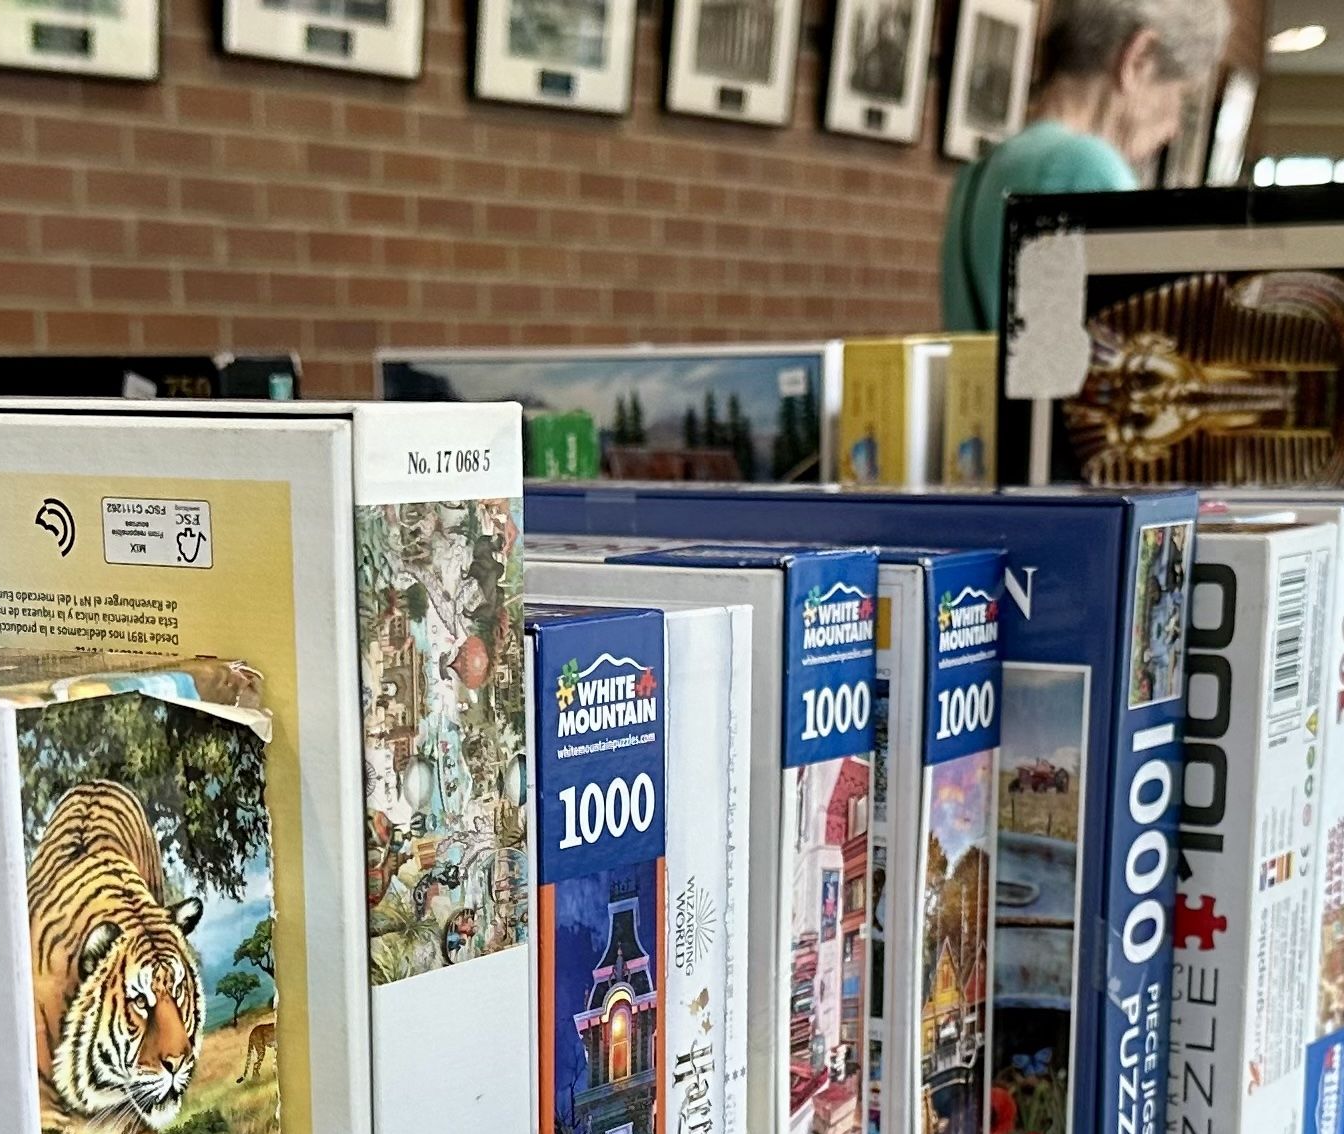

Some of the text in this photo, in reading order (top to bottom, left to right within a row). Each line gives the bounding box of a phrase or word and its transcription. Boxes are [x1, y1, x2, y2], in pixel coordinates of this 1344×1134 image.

[407, 449, 492, 476] No. 17 068 5
[175, 514, 201, 526] FSC
[130, 543, 146, 554] MIX
[16, 590, 55, 603] mercado
[57, 594, 72, 606] del
[94, 597, 101, 608] el
[165, 601, 178, 612] de
[8, 607, 20, 619] de
[22, 607, 55, 621] riqueza
[58, 610, 66, 622] la
[103, 612, 156, 626] experiencia
[818, 600, 860, 625] WHITE
[952, 603, 987, 629] WHITE
[40, 625, 48, 636] la
[58, 625, 107, 641] dedicamos
[158, 617, 179, 629] Esta
[109, 630, 125, 640] nos
[127, 632, 147, 644] 1891
[150, 633, 179, 646] Desde
[803, 619, 873, 650] MOUNTAIN
[939, 622, 998, 653] MOUNTAIN
[577, 674, 636, 707] WHITE
[557, 697, 657, 738] MOUNTAIN
[802, 680, 870, 741] 1000
[936, 680, 995, 741] 1000
[1177, 563, 1238, 881] 1000
[557, 732, 656, 760] whitemountainpuzzles.com
[558, 772, 655, 850] 1000
[1122, 722, 1175, 967] 1000
[675, 891, 687, 970] WORLD
[685, 875, 697, 977] WIZARDING
[1143, 984, 1163, 1076] PIECE
